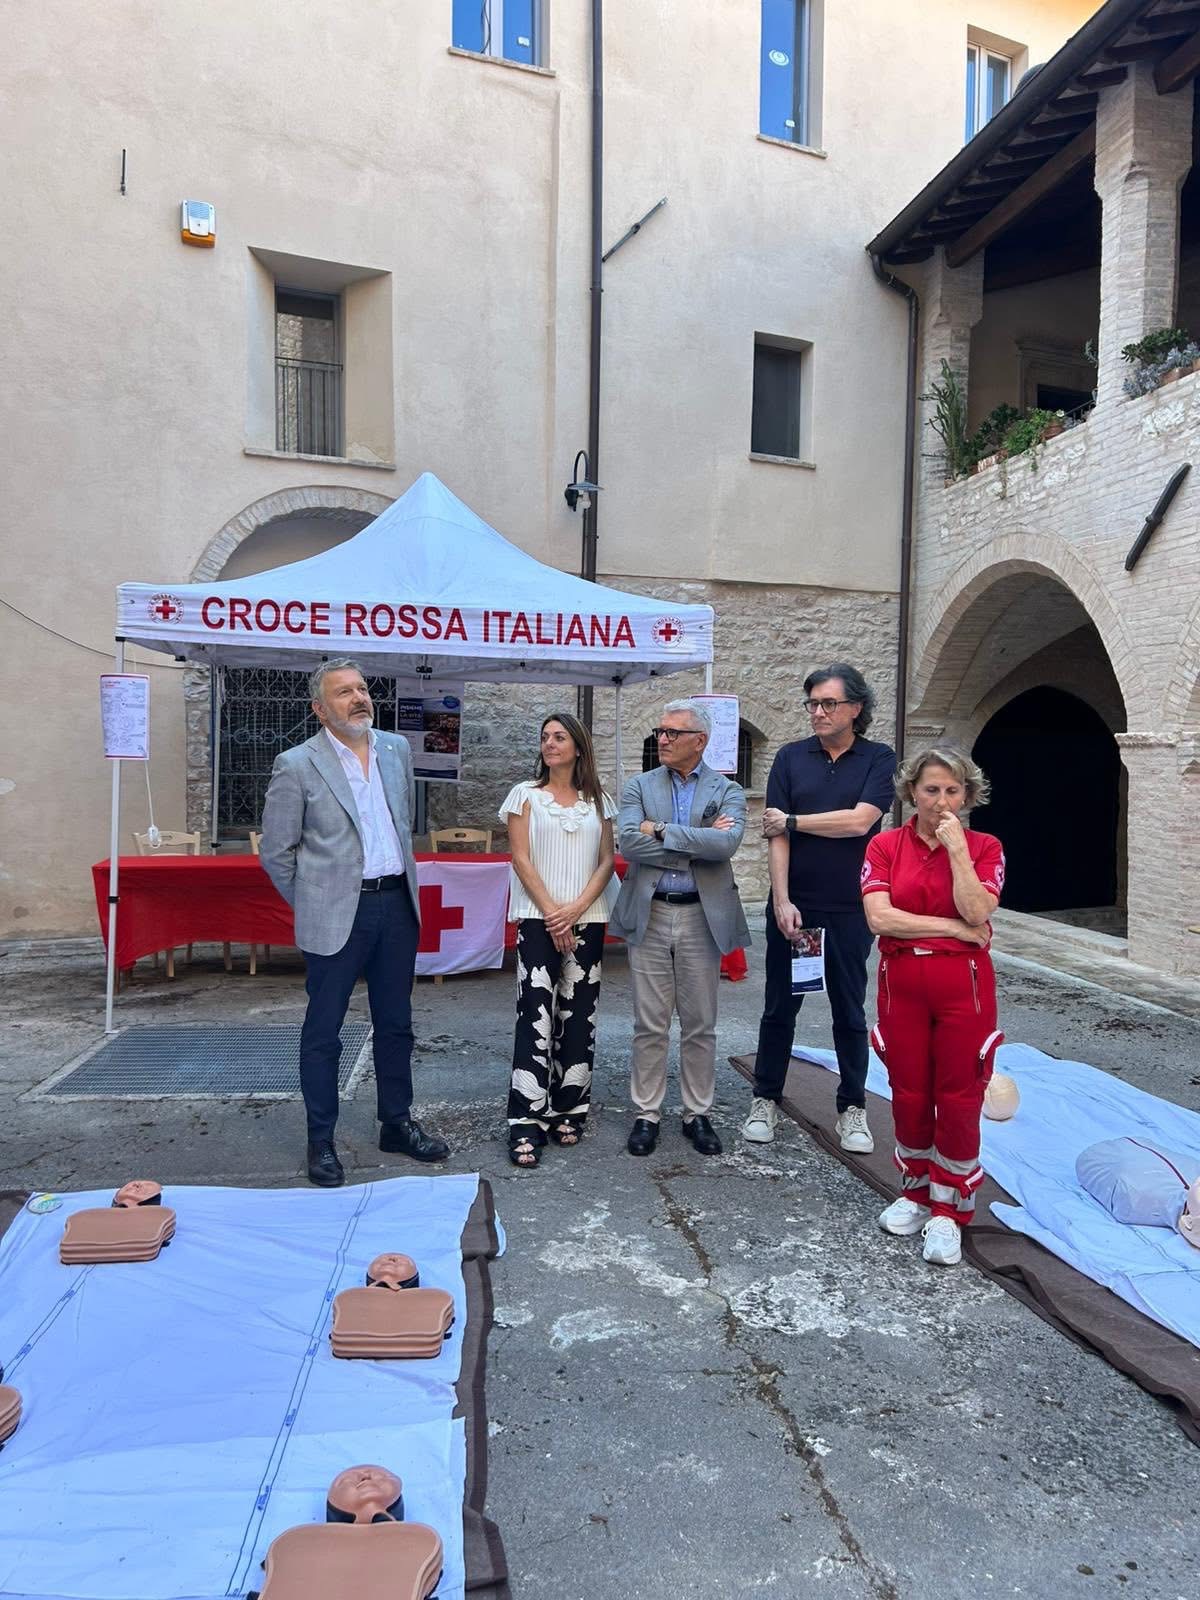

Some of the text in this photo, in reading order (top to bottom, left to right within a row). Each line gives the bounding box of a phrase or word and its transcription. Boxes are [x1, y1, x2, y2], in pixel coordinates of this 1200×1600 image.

[201, 596, 331, 635] CROCE
[345, 603, 468, 641] ROSSA
[483, 610, 636, 648] ITALIANA
